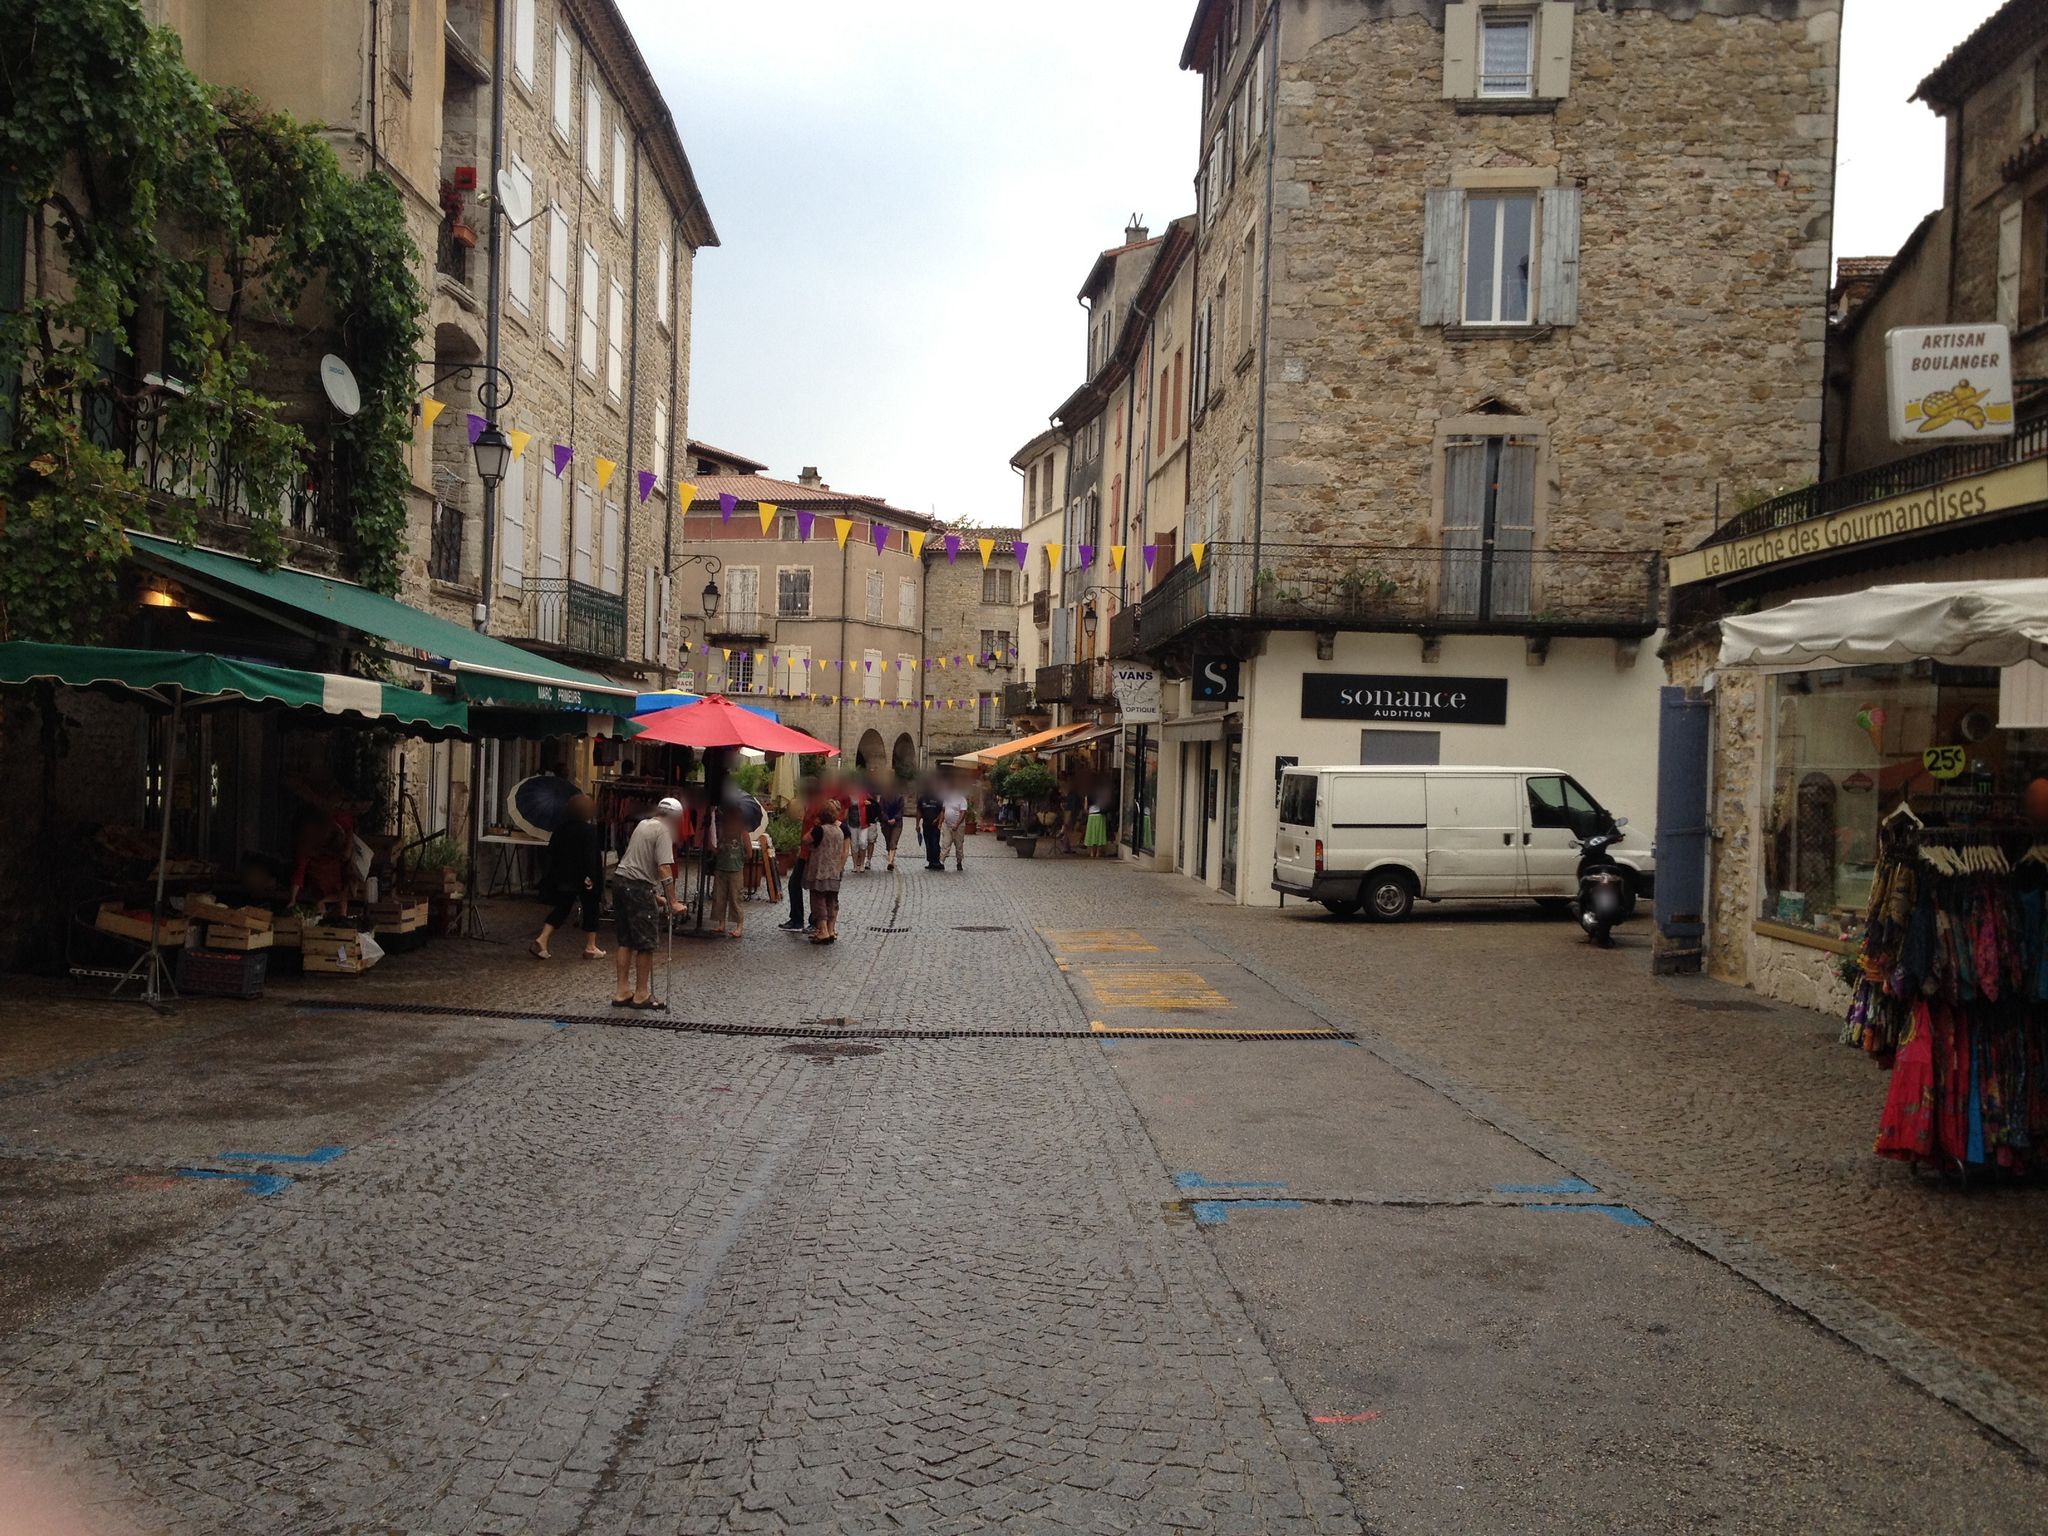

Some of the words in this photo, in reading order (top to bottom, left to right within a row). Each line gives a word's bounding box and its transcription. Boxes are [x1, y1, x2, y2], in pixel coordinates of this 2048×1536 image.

[1922, 332, 1986, 350] ARTISAN
[1911, 353, 2000, 371] BOULANGER
[1703, 550, 1720, 576] Le
[1723, 527, 1785, 572] Marché
[1788, 527, 1820, 556] des
[1824, 485, 1987, 547] Gourmandises
[1119, 671, 1153, 680] VANS
[537, 685, 553, 701] MARC
[1341, 689, 1467, 708] sonance
[1374, 709, 1431, 718] AUDITION
